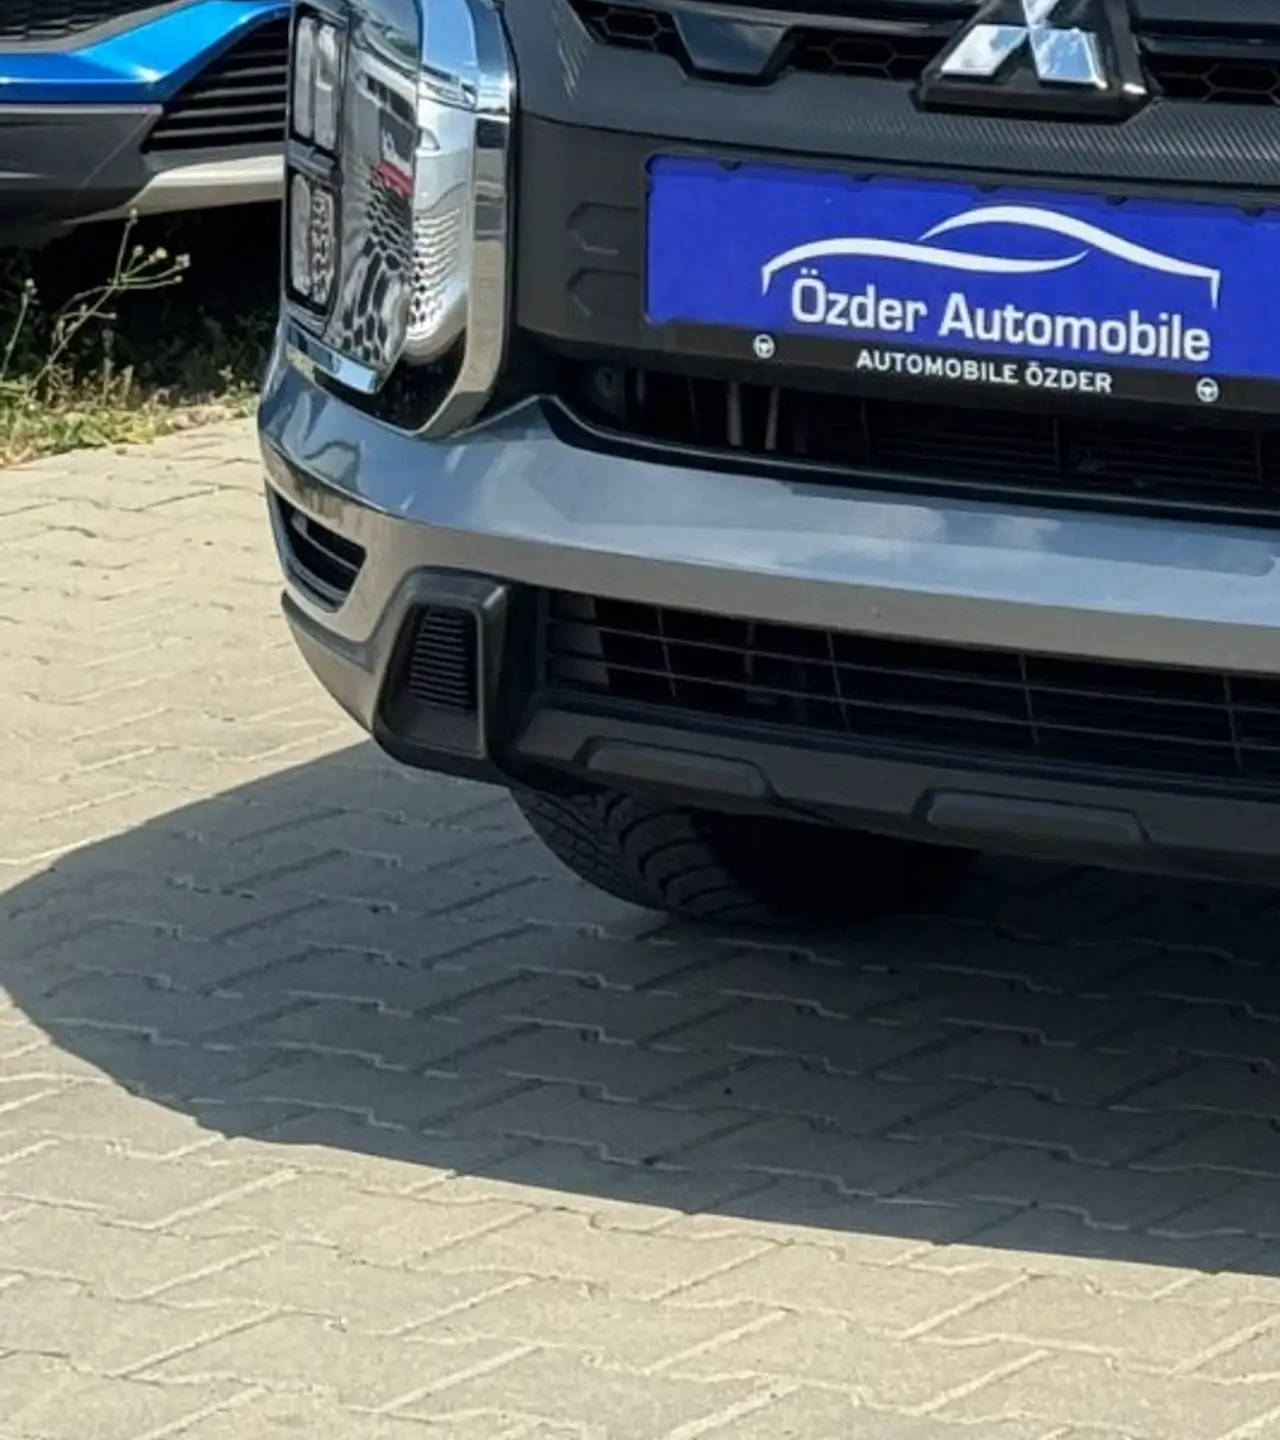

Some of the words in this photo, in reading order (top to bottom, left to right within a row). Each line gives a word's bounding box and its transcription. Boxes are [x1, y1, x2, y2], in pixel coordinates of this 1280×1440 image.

[791, 266, 929, 334] Özder
[937, 291, 1211, 362] Automobile
[855, 348, 1019, 385] AUTOMOBILE
[1024, 361, 1113, 393] ÖZDER
